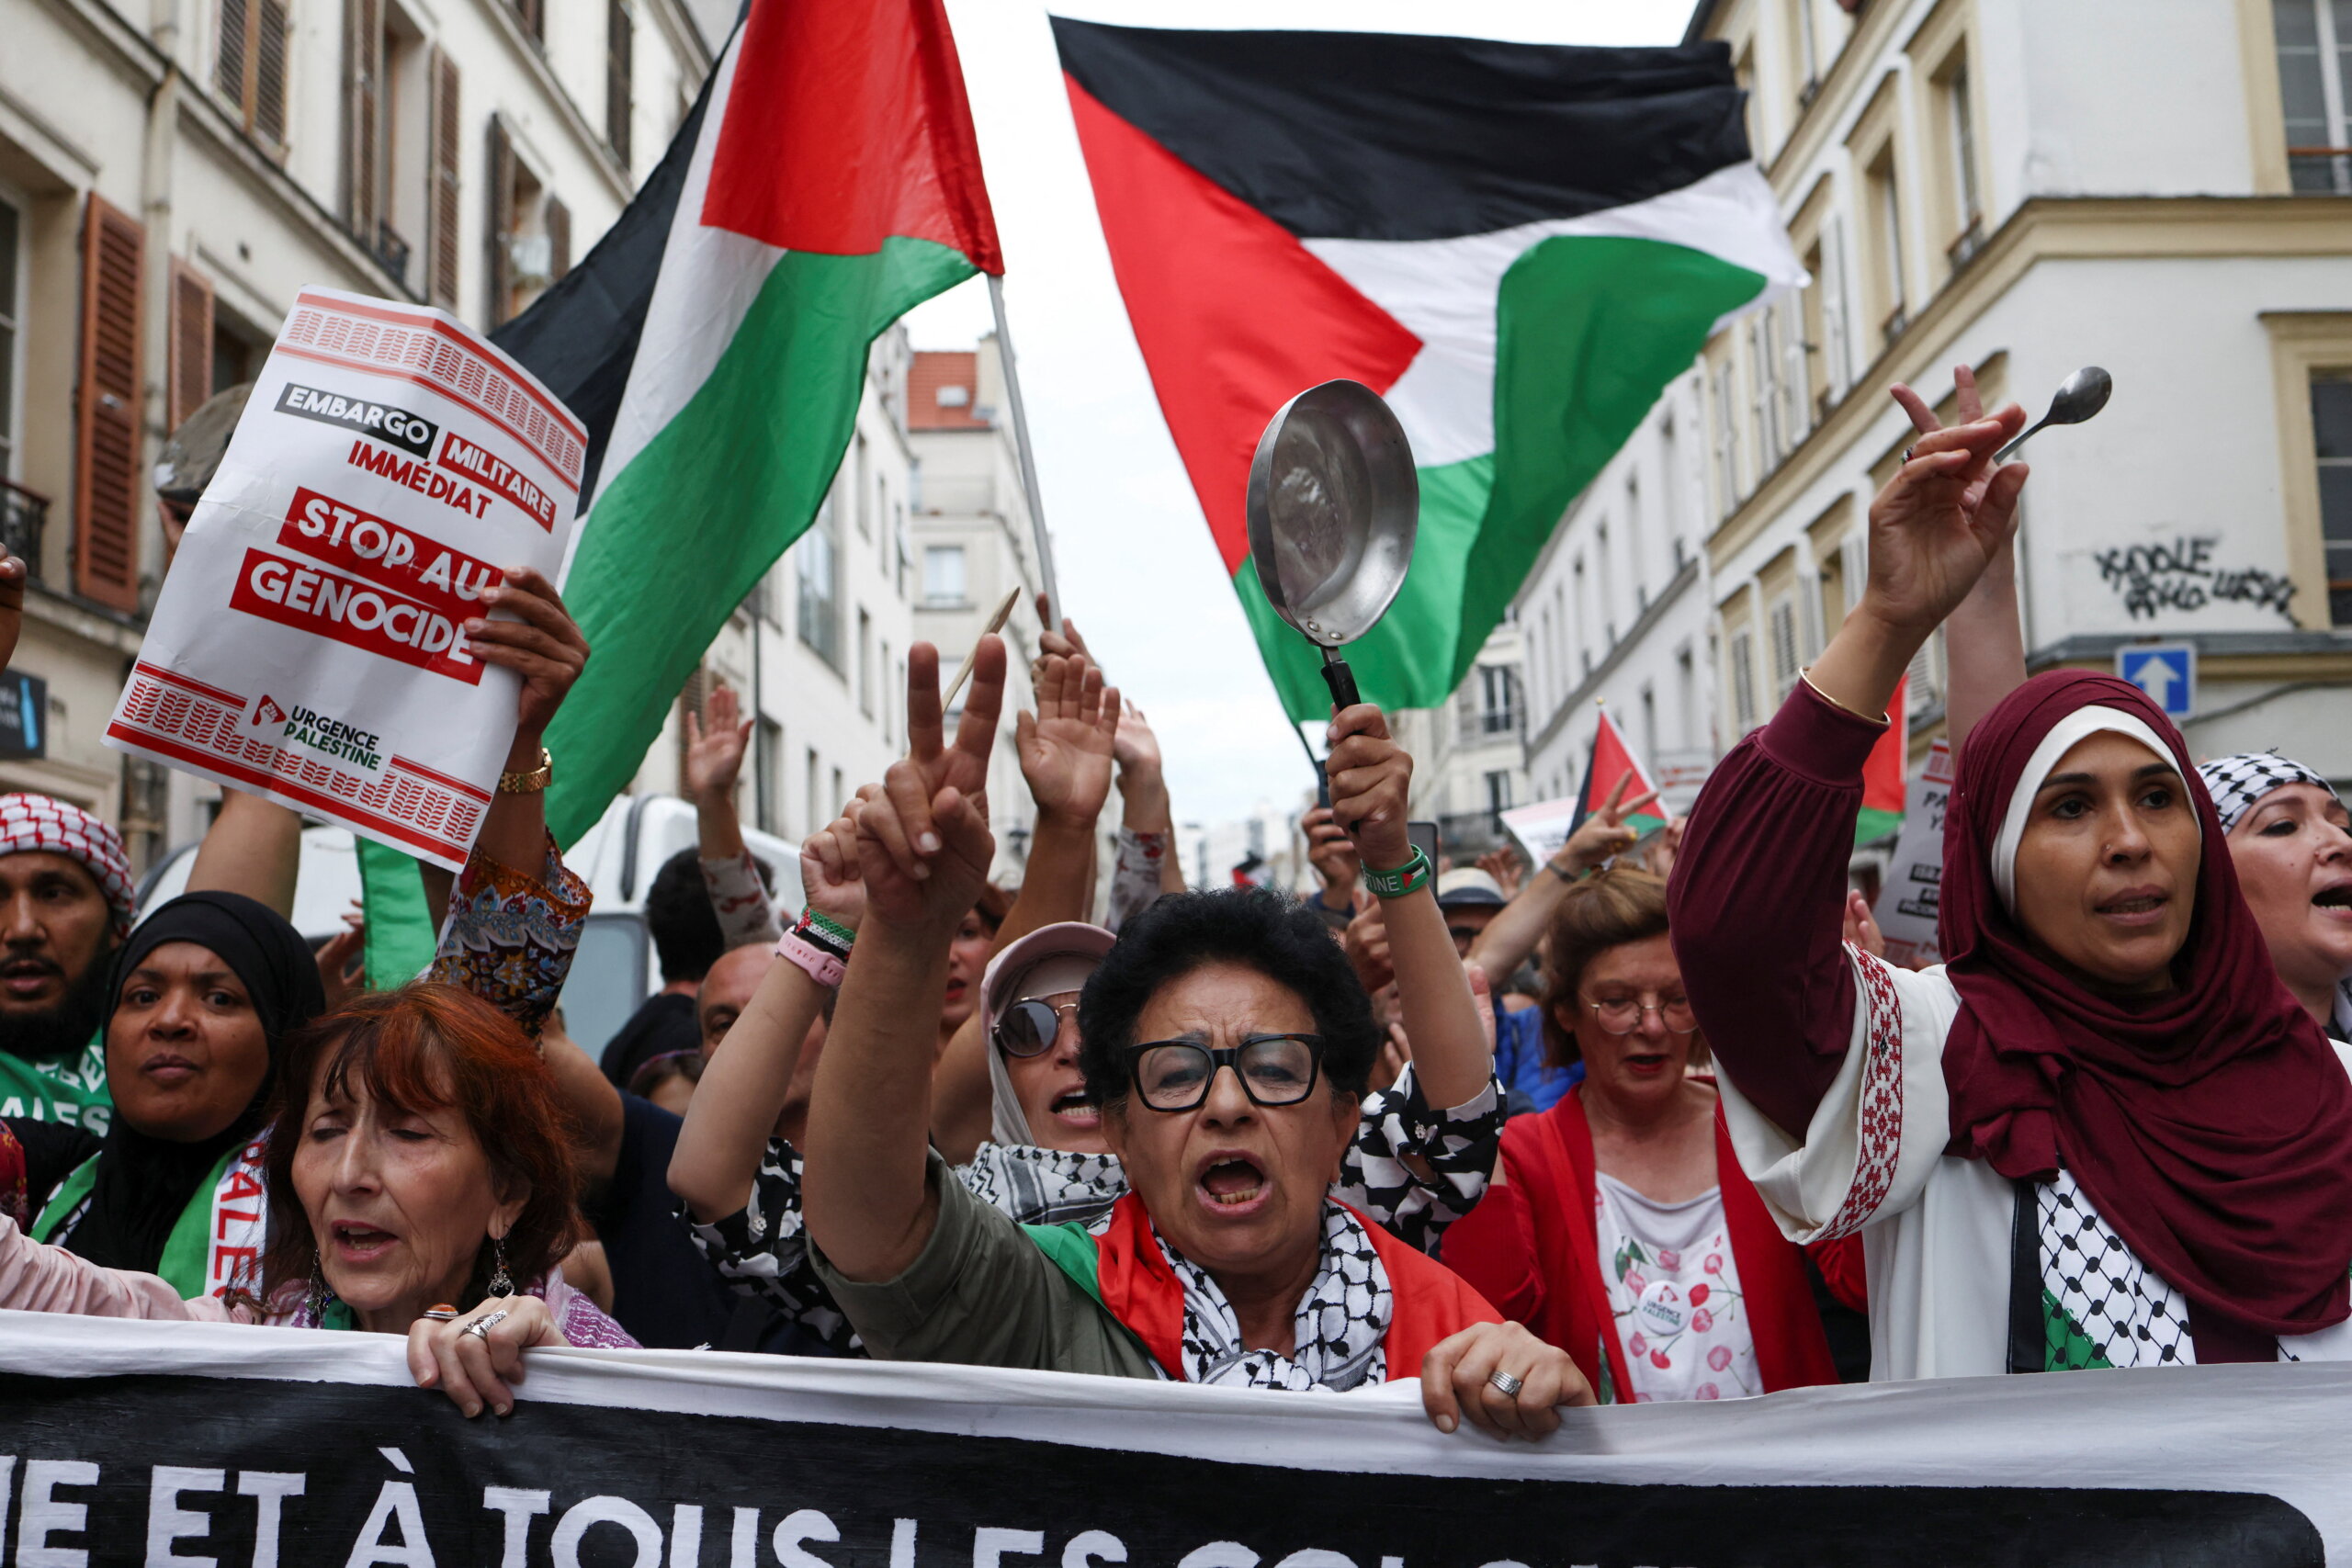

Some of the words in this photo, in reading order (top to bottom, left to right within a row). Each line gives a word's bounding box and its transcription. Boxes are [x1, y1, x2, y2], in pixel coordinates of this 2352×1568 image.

[285, 386, 430, 445] EMBARGO
[446, 437, 552, 523] MILITAIRE
[347, 440, 493, 520] IMMÉDIAT
[298, 498, 415, 570] STOP
[418, 550, 492, 602] AU
[250, 561, 475, 666] GÉNOCIDE
[283, 720, 382, 772] PALESTINE
[291, 705, 380, 752] URGENCE
[0, 1454, 100, 1568] E
[144, 1464, 307, 1568] ET
[344, 1447, 436, 1568] À
[482, 1484, 841, 1568] TOUS
